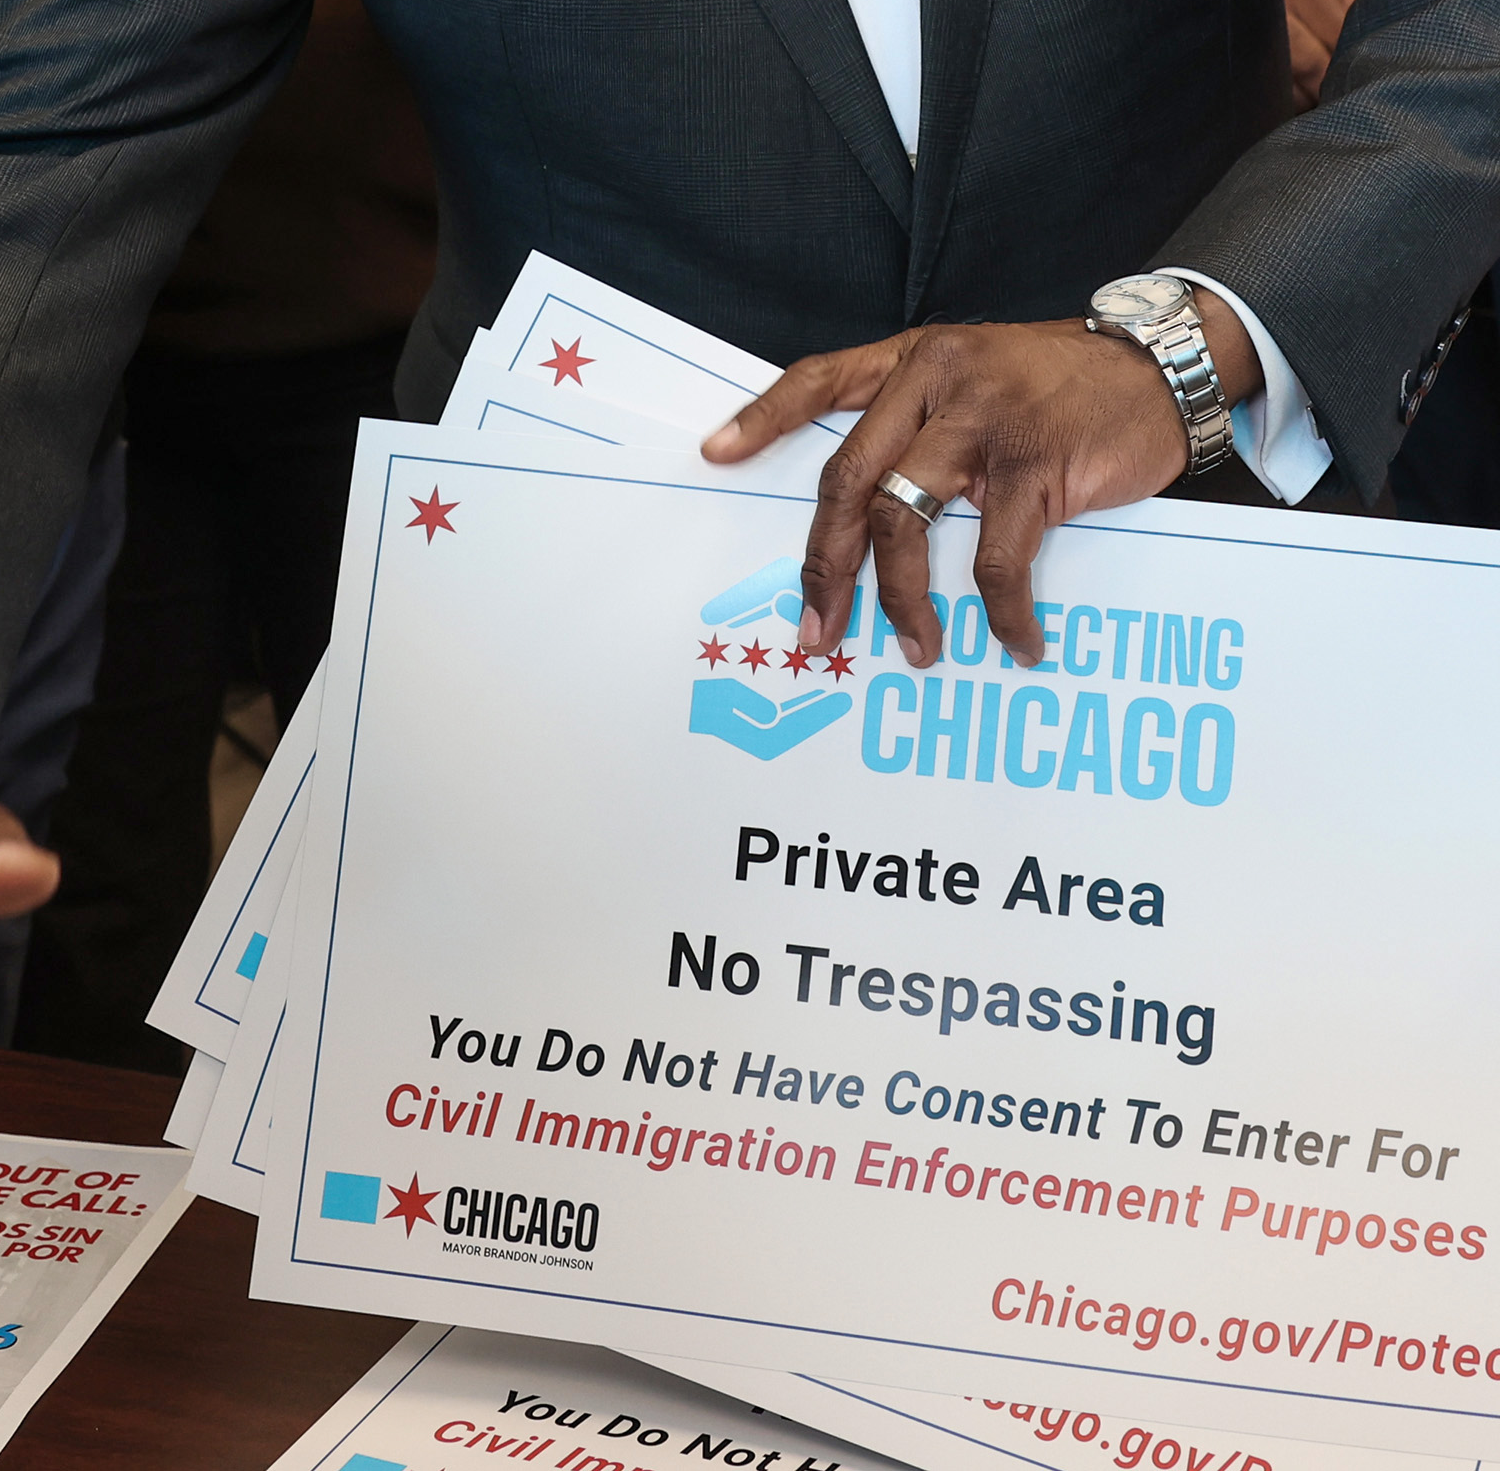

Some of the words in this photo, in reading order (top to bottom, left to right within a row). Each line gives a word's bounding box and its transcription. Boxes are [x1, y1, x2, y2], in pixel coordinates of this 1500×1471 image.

[861, 672, 1236, 807] CHICAGO
[735, 826, 980, 906] Private
[1002, 856, 1166, 927] Area
[667, 931, 761, 996] No
[785, 944, 1216, 1066] Trespassing
[426, 1015, 521, 1069] You
[537, 1029, 606, 1078] Do
[623, 1039, 718, 1089] Not
[732, 1052, 864, 1110] Have
[883, 1070, 1107, 1140] Consent
[1127, 1099, 1183, 1149] To
[1202, 1109, 1352, 1169] Enter
[1366, 1128, 1460, 1181] For
[20, 1189, 147, 1217] CALL:
[74, 1171, 141, 1191] OF
[385, 1083, 504, 1140] Civil
[514, 1099, 837, 1181] Immigration
[853, 1140, 1205, 1228] Enforcement
[1220, 1187, 1488, 1261] Purposes
[1, 1242, 85, 1263] POR
[33, 1226, 103, 1245] SIN
[443, 1186, 600, 1253] CHICAGO
[442, 1241, 482, 1257] MAYOR
[483, 1247, 538, 1264] BRANDON
[539, 1255, 594, 1272] JOHNSON
[432, 1419, 554, 1461] Civil
[497, 1390, 592, 1428] You
[598, 1414, 669, 1448] Do
[682, 1433, 782, 1471] Not
